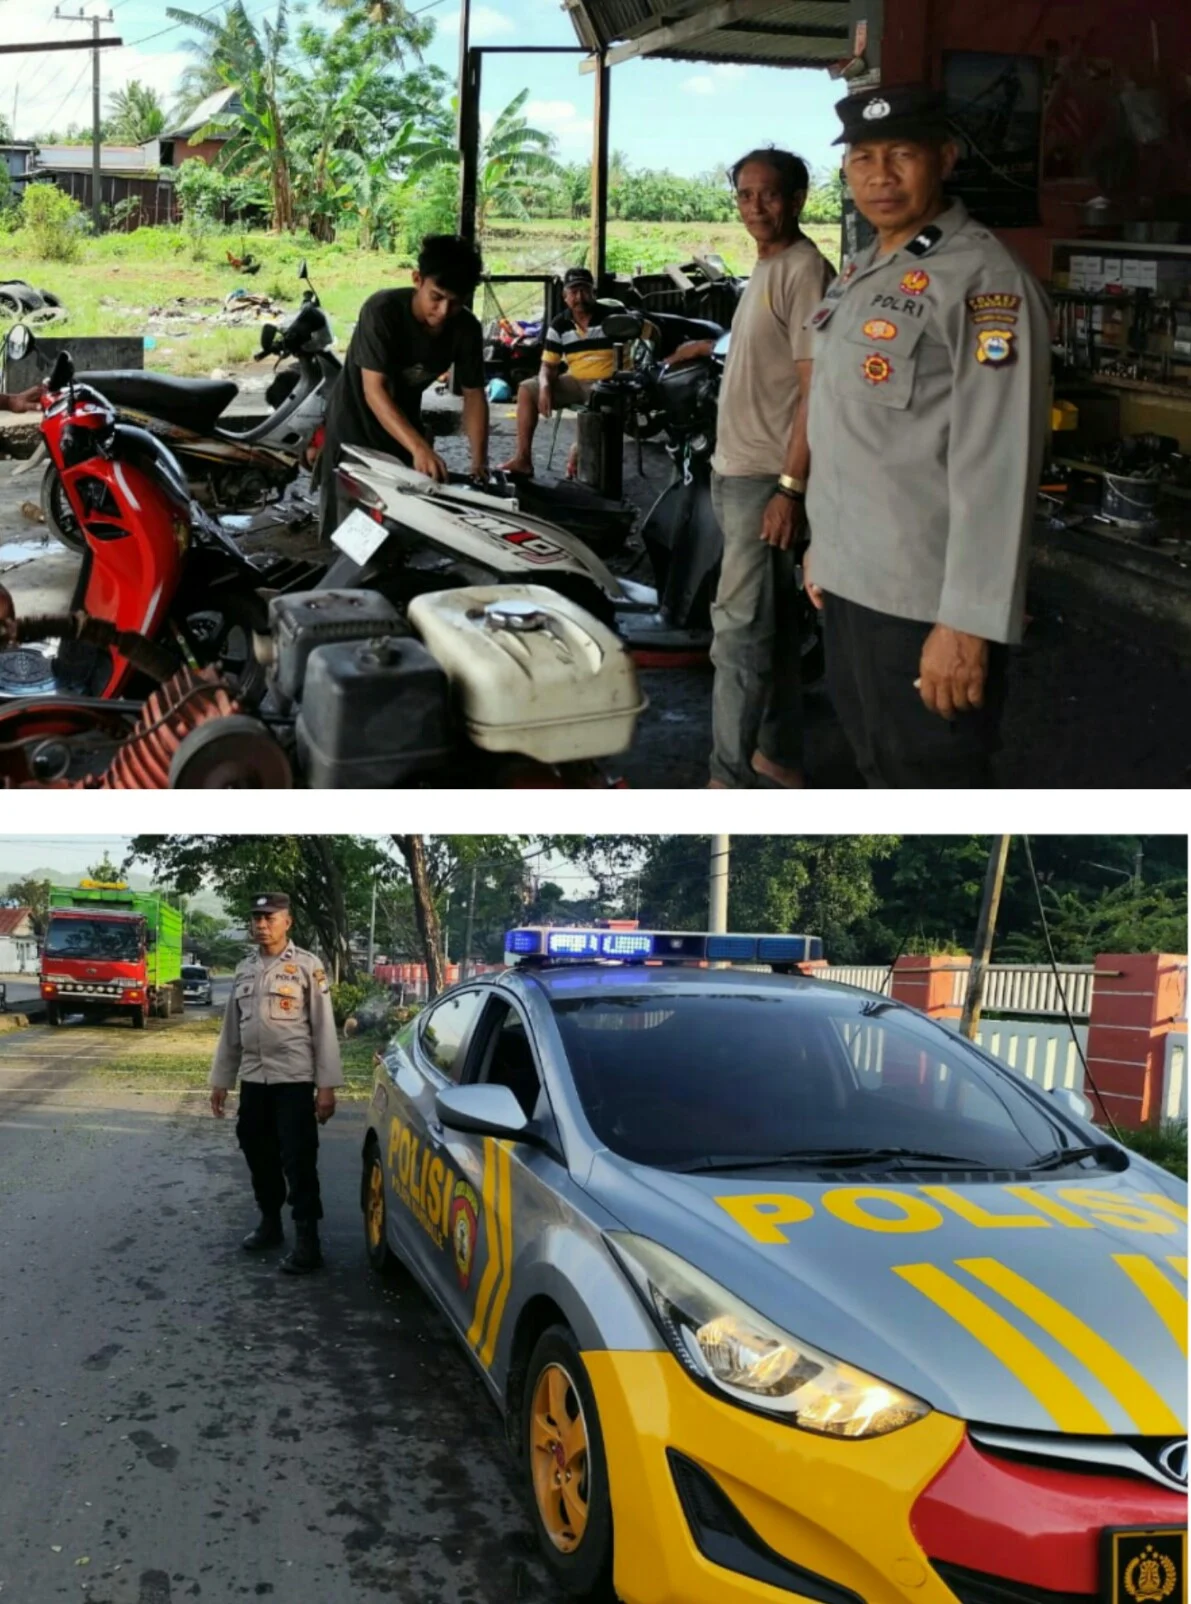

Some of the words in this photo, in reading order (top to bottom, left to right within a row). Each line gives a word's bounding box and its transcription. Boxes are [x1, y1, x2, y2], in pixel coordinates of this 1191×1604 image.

[870, 294, 924, 318] POLRI
[387, 1115, 455, 1239] POLISI
[713, 1185, 1188, 1244] POLISI
